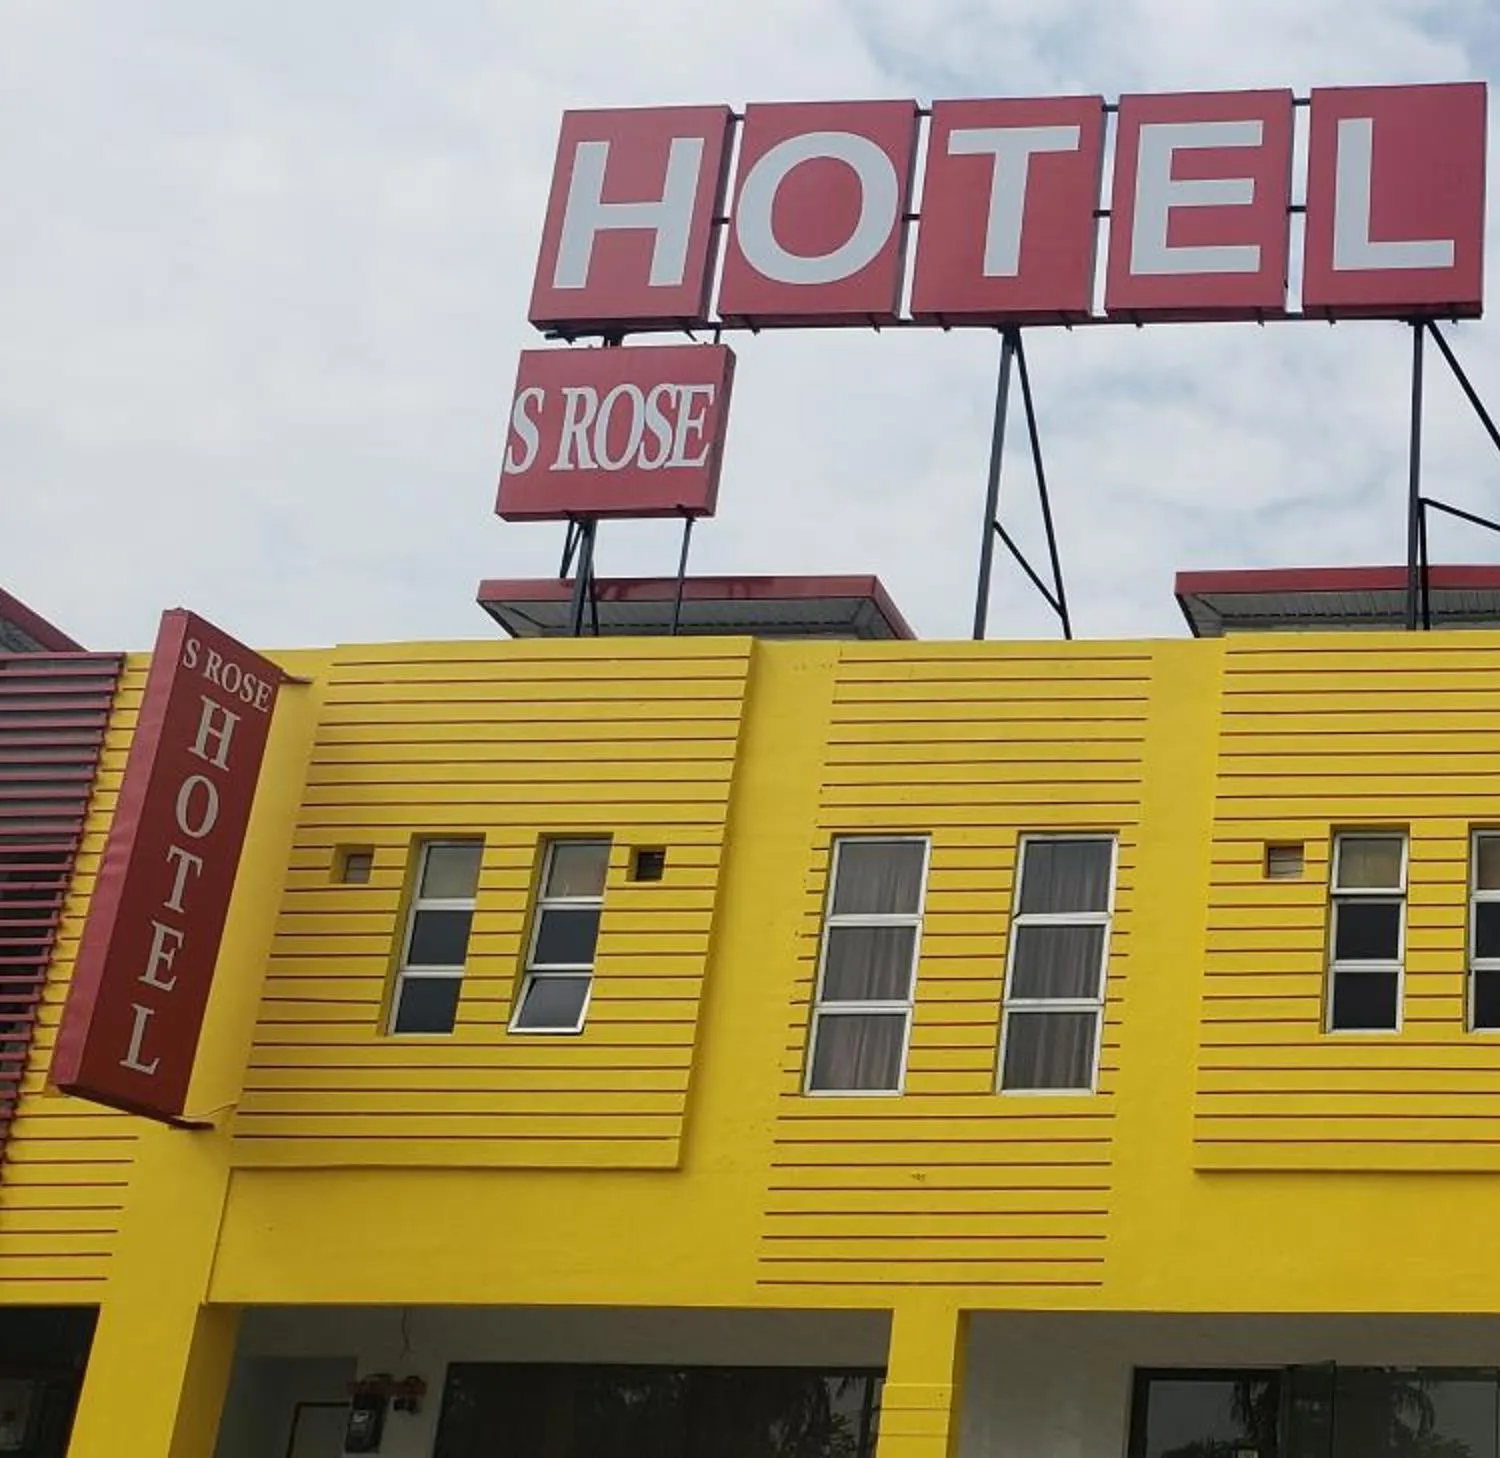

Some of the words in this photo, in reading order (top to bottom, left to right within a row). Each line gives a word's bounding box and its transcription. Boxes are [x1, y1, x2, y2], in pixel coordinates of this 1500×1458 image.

[551, 117, 1455, 290] HOTEL
[504, 385, 545, 475] S
[550, 382, 716, 474] ROSE
[182, 638, 202, 671] S
[203, 648, 273, 713] ROSE
[119, 695, 242, 1076] HOTEL
